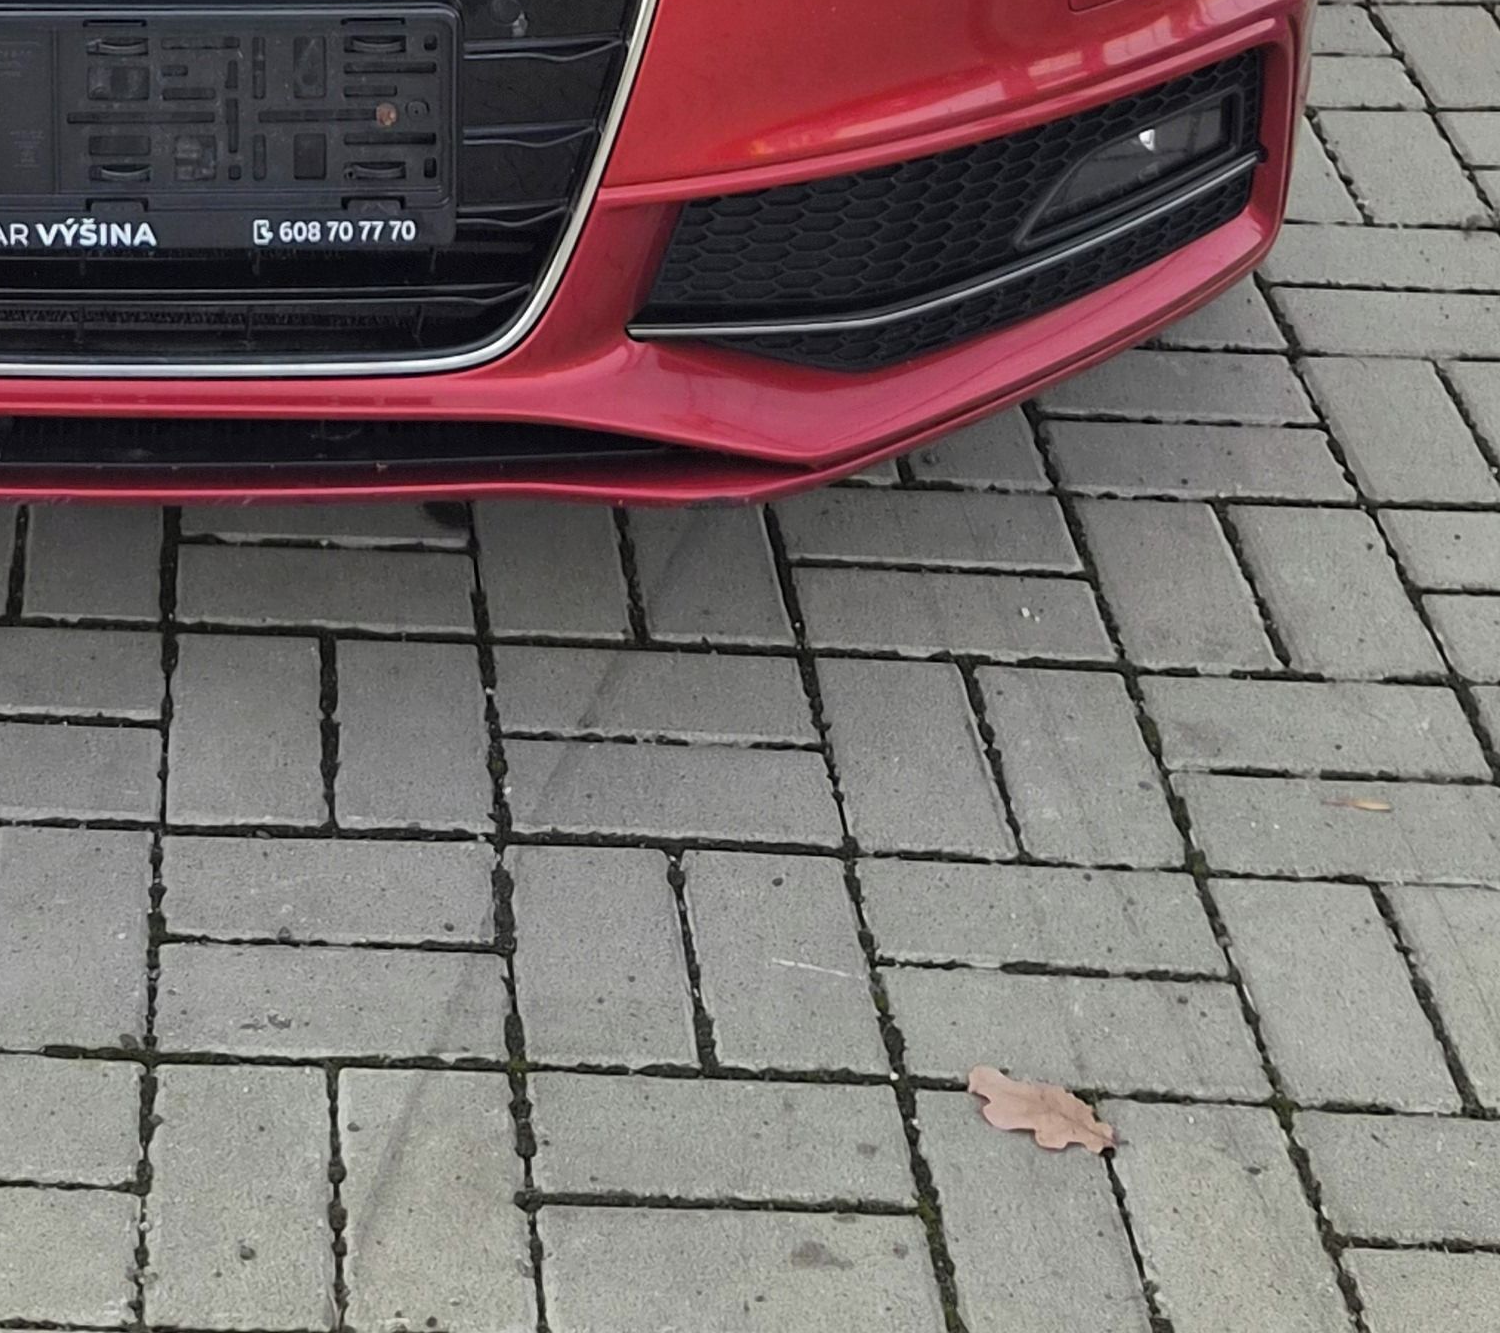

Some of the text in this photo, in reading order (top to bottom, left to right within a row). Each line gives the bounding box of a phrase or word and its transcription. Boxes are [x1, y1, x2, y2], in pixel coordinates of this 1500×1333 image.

[35, 217, 157, 247] VÝŠINA
[279, 219, 417, 243] 608 70 77 70
